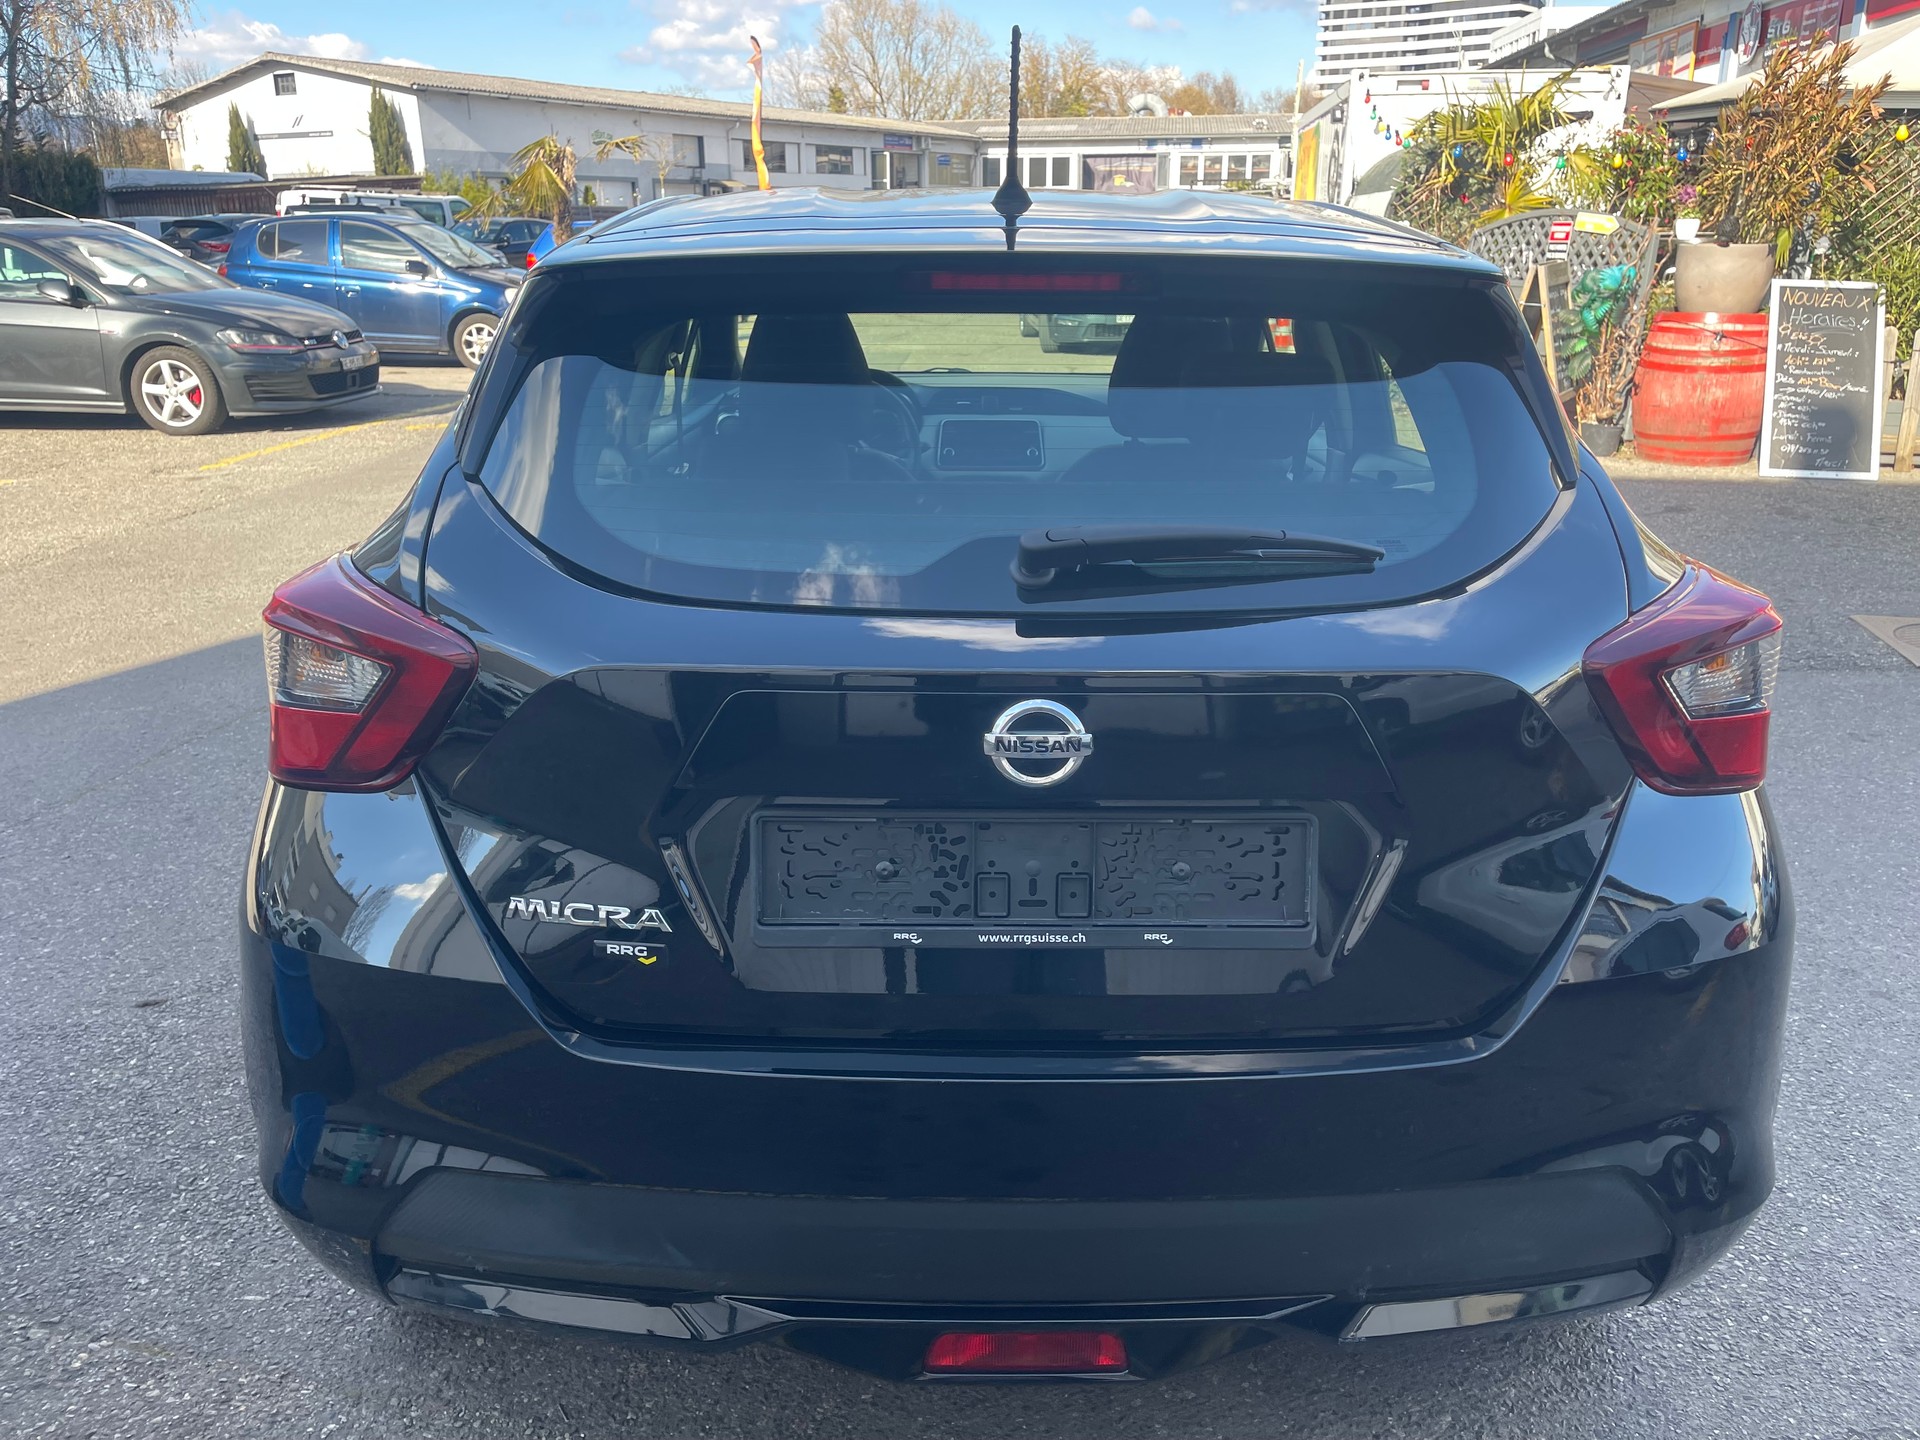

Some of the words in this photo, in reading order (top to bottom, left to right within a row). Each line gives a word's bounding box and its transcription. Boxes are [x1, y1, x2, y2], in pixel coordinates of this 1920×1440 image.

[1783, 288, 1871, 312] NOUVEAUX
[994, 735, 1083, 753] NISSAN
[505, 896, 673, 932] MICRA
[978, 932, 1087, 945] www.rrgsuisse.ch
[606, 943, 648, 957] RRG
